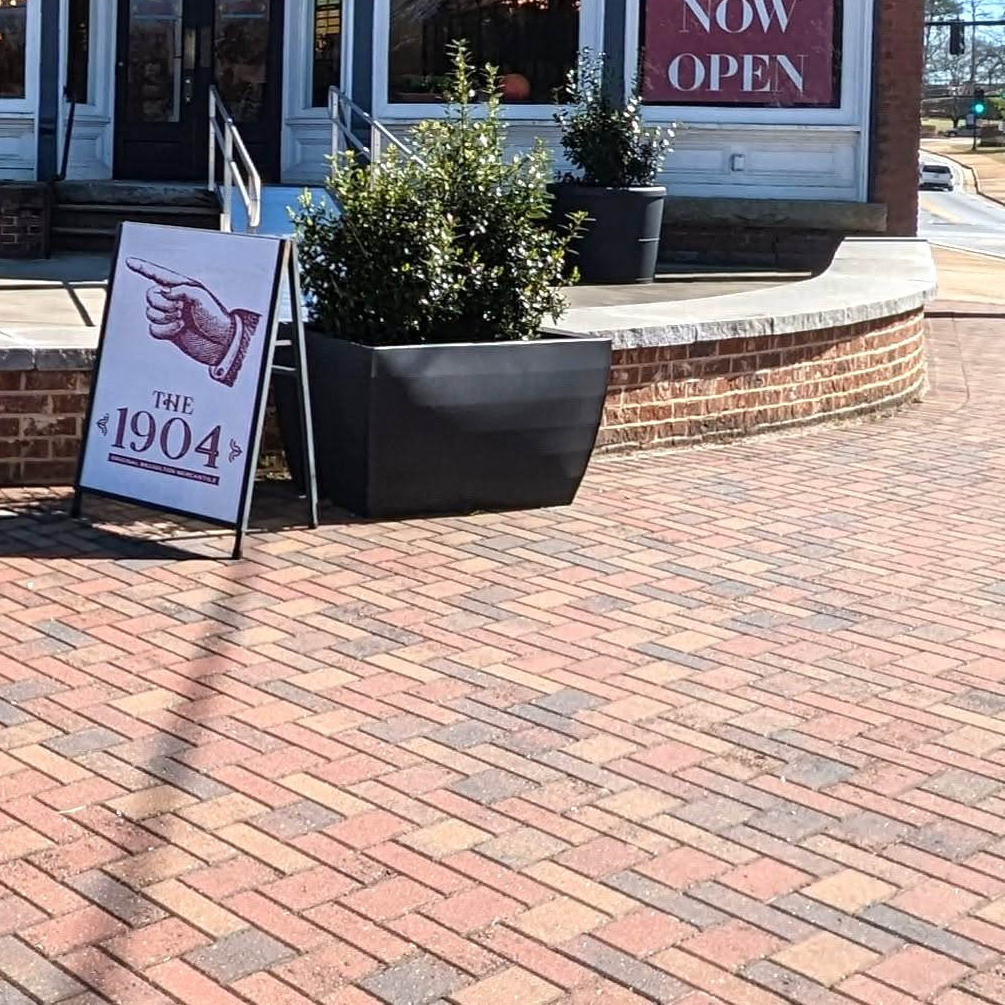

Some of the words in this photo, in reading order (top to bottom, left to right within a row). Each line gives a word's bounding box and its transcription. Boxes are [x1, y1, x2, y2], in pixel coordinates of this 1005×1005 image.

[667, 52, 810, 98] OPEN
[152, 390, 196, 415] THE
[110, 406, 222, 470] 1904
